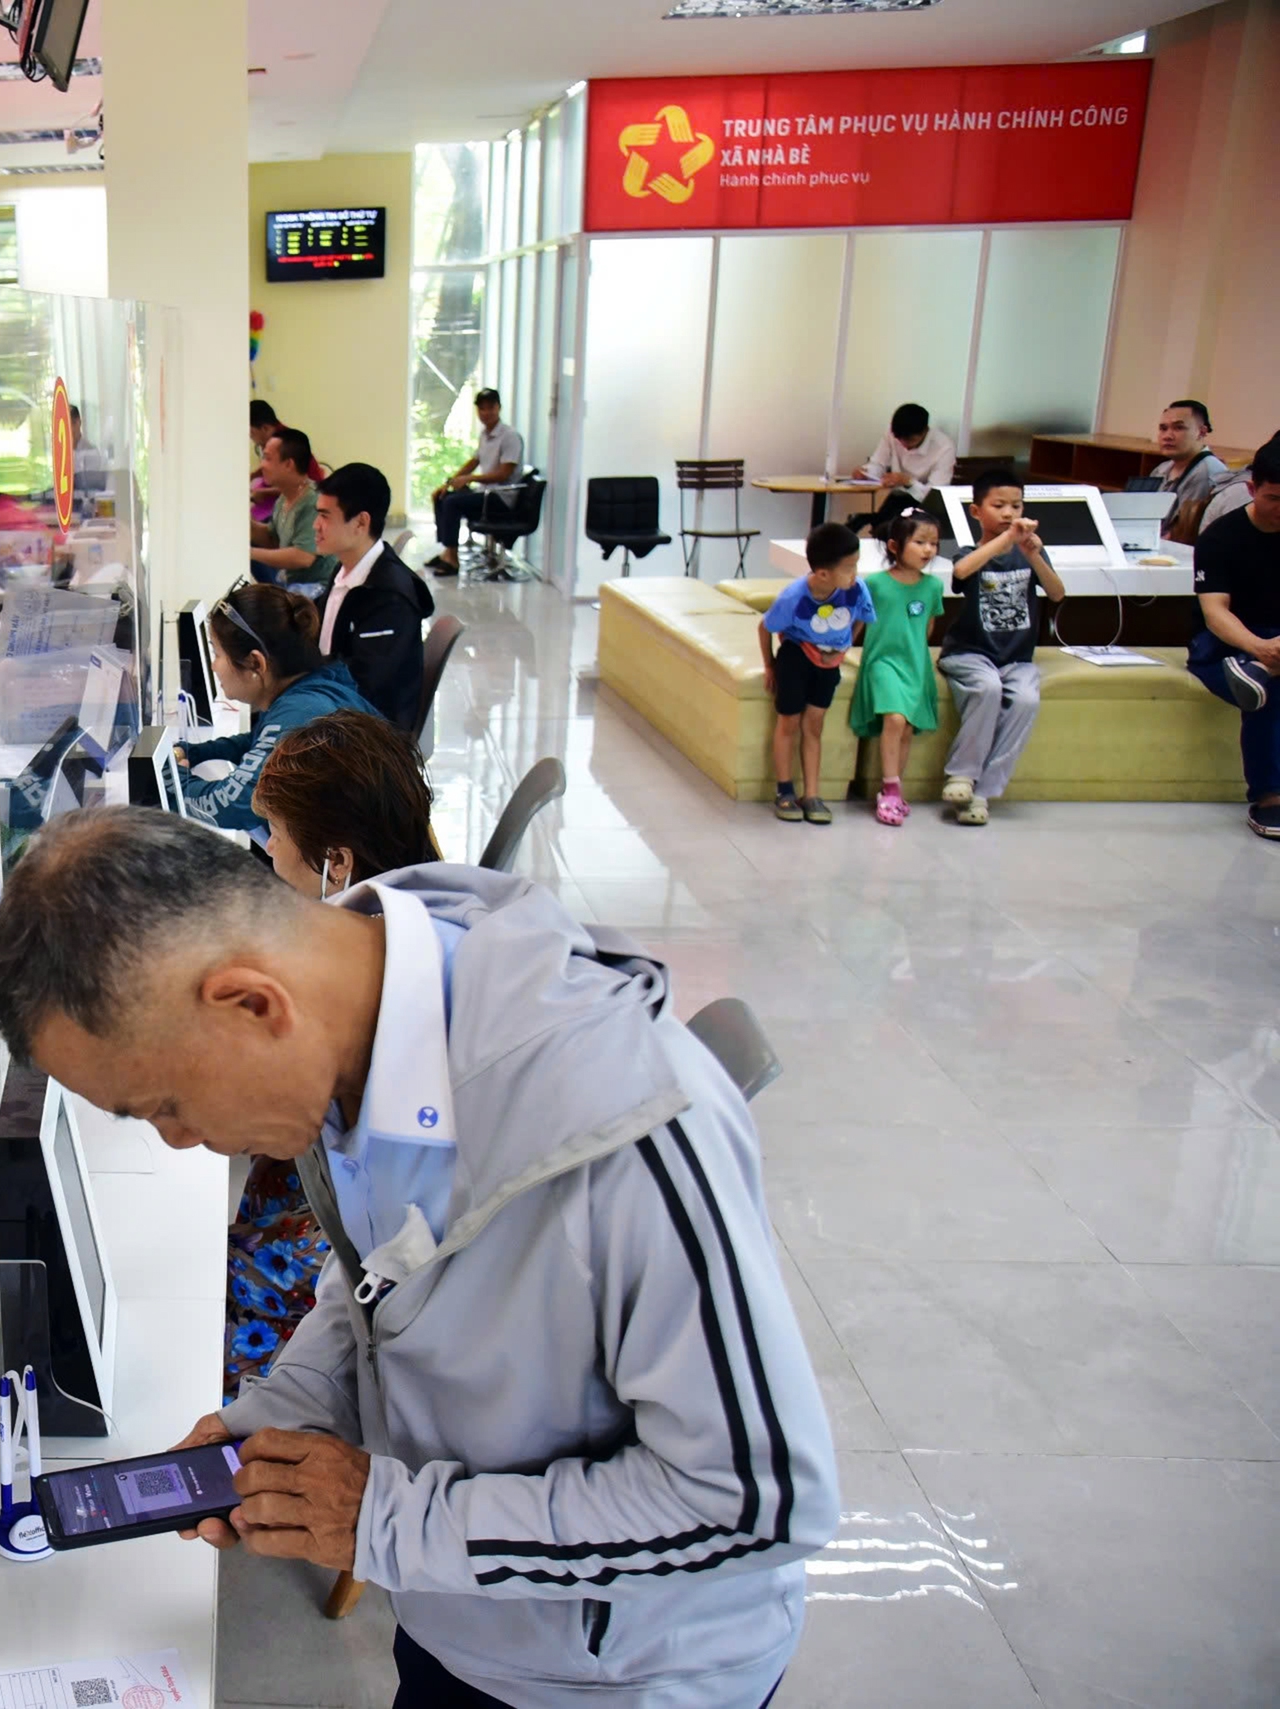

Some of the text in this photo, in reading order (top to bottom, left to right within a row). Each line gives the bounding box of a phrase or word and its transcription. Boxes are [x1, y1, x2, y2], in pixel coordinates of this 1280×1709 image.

[723, 104, 1129, 137] TRUNG TÂM PHỤC VỤ HÀNH CHÍNH CÔNG
[721, 143, 811, 167] XÃ NHÀ BÈ
[720, 171, 870, 188] Hành chính phục vụ
